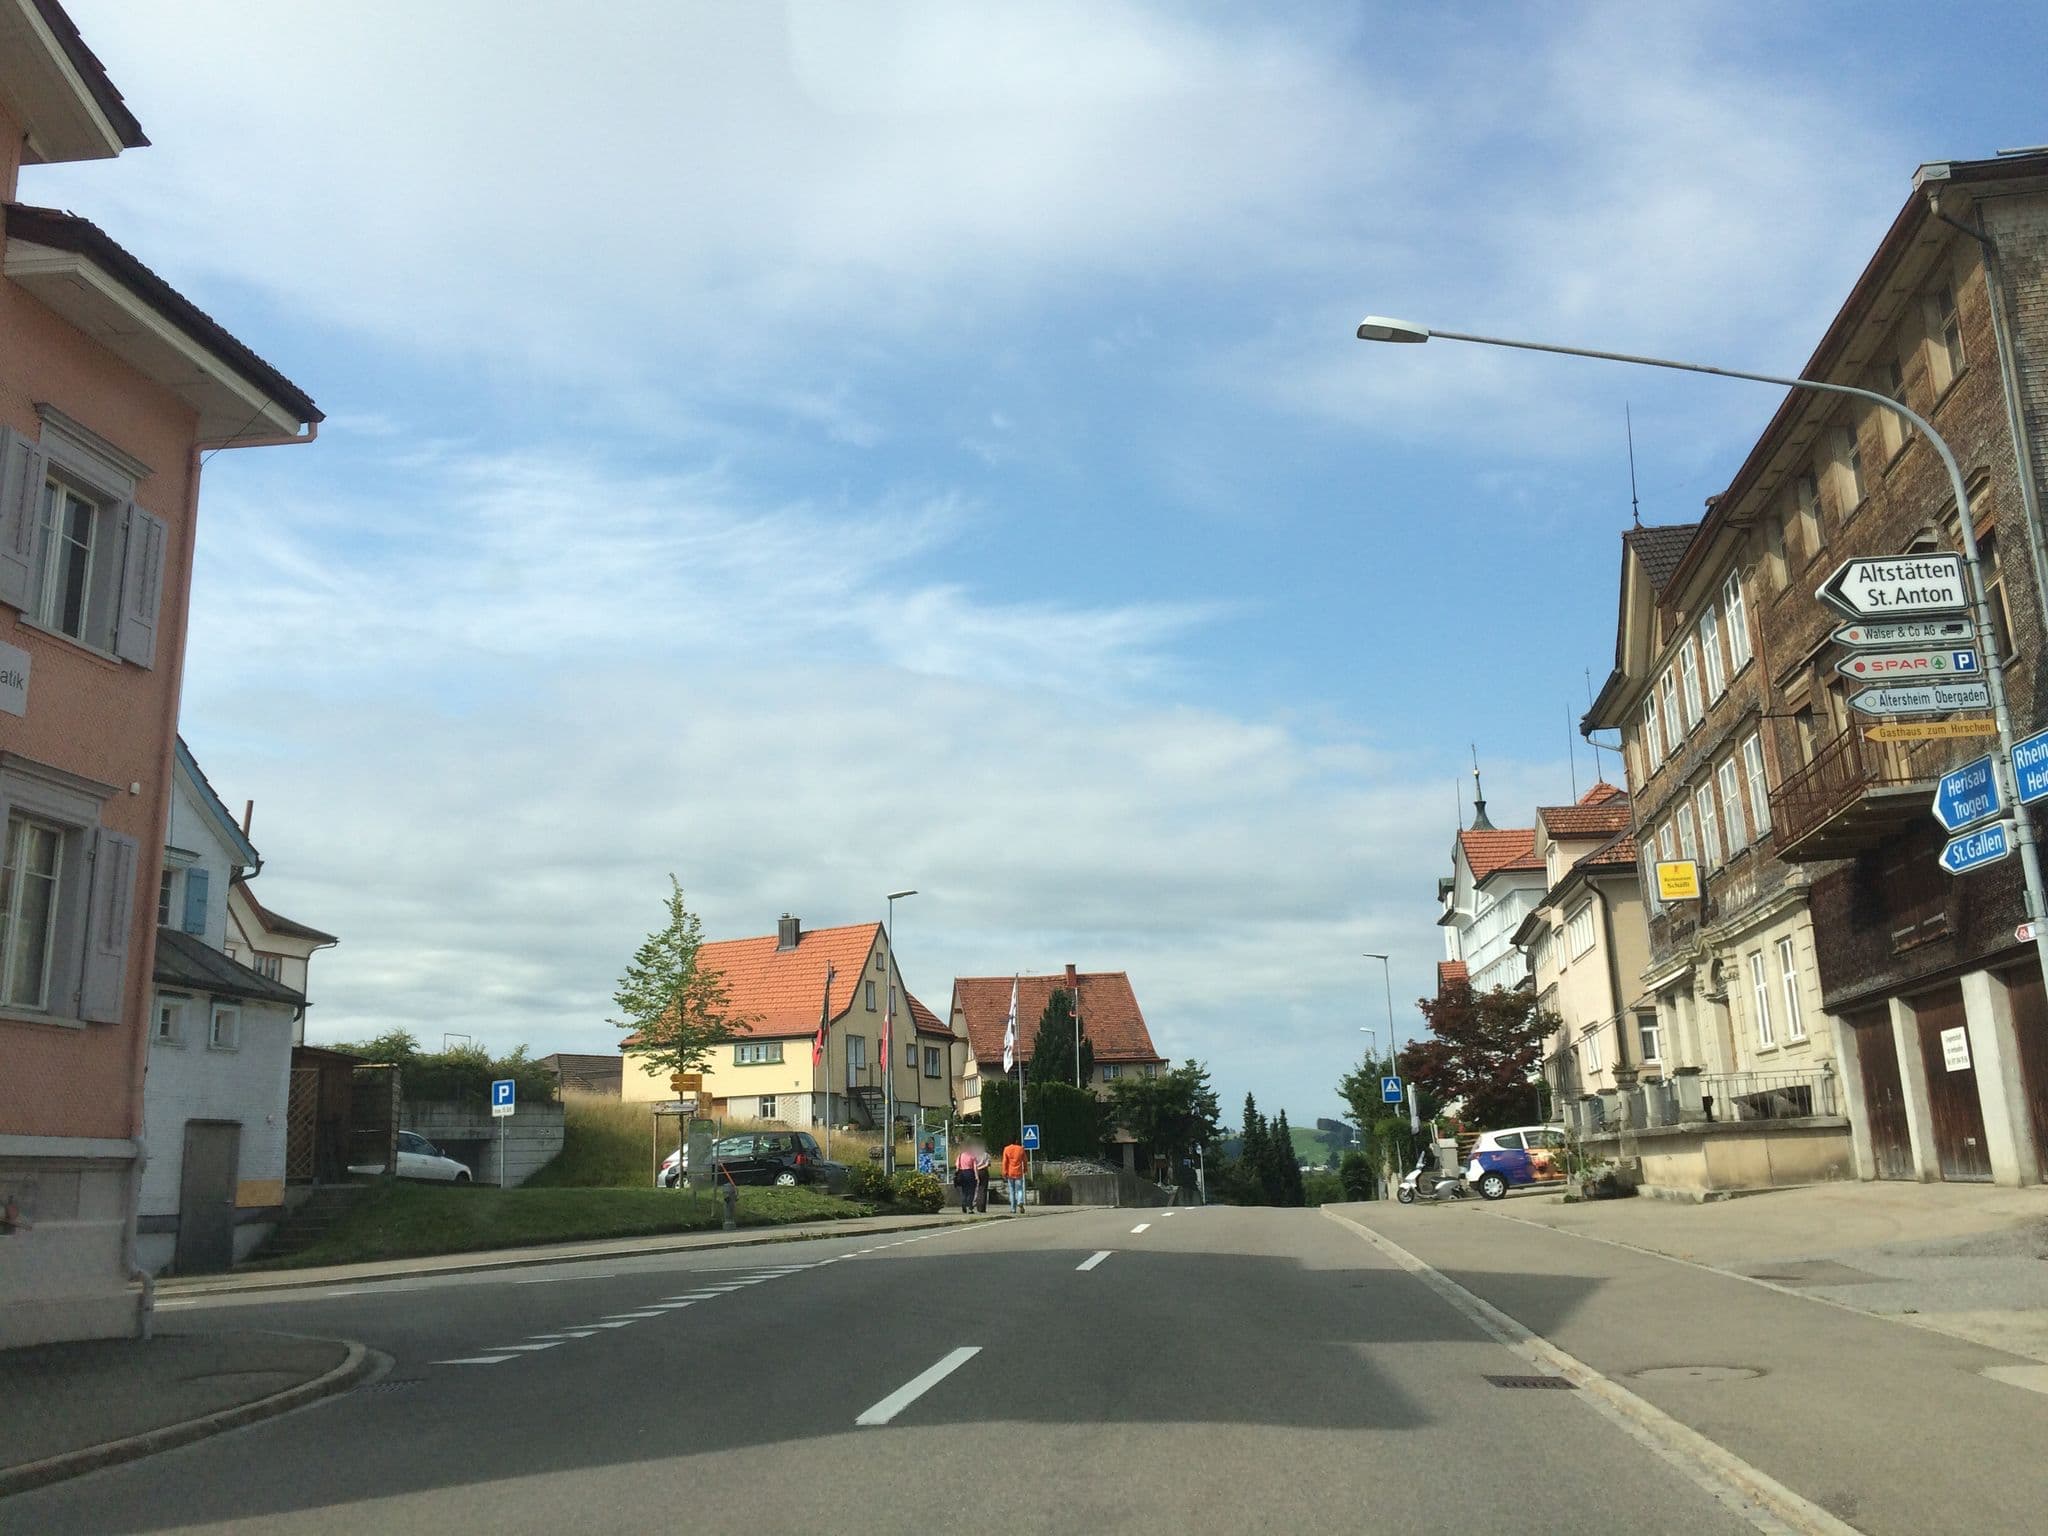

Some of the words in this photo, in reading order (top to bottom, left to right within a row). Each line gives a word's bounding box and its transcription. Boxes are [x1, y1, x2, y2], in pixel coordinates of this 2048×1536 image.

[1859, 563, 1956, 583] Altstätten
[1864, 627, 1894, 640] Walser
[1897, 626, 1906, 637] &
[1908, 625, 1921, 637] Co
[1924, 624, 1936, 636] AG
[1871, 658, 1928, 672] SPAR
[1958, 653, 1970, 669] P
[1879, 692, 1931, 707] Altersheim
[1935, 689, 1986, 706] Obergaden
[1879, 726, 1922, 738] Gasthaus
[1927, 726, 1947, 735] zum
[1951, 722, 1991, 734] Hirschen
[1947, 768, 1987, 798] Herisau
[1953, 793, 1989, 820] Trogen
[499, 1085, 509, 1103] P
